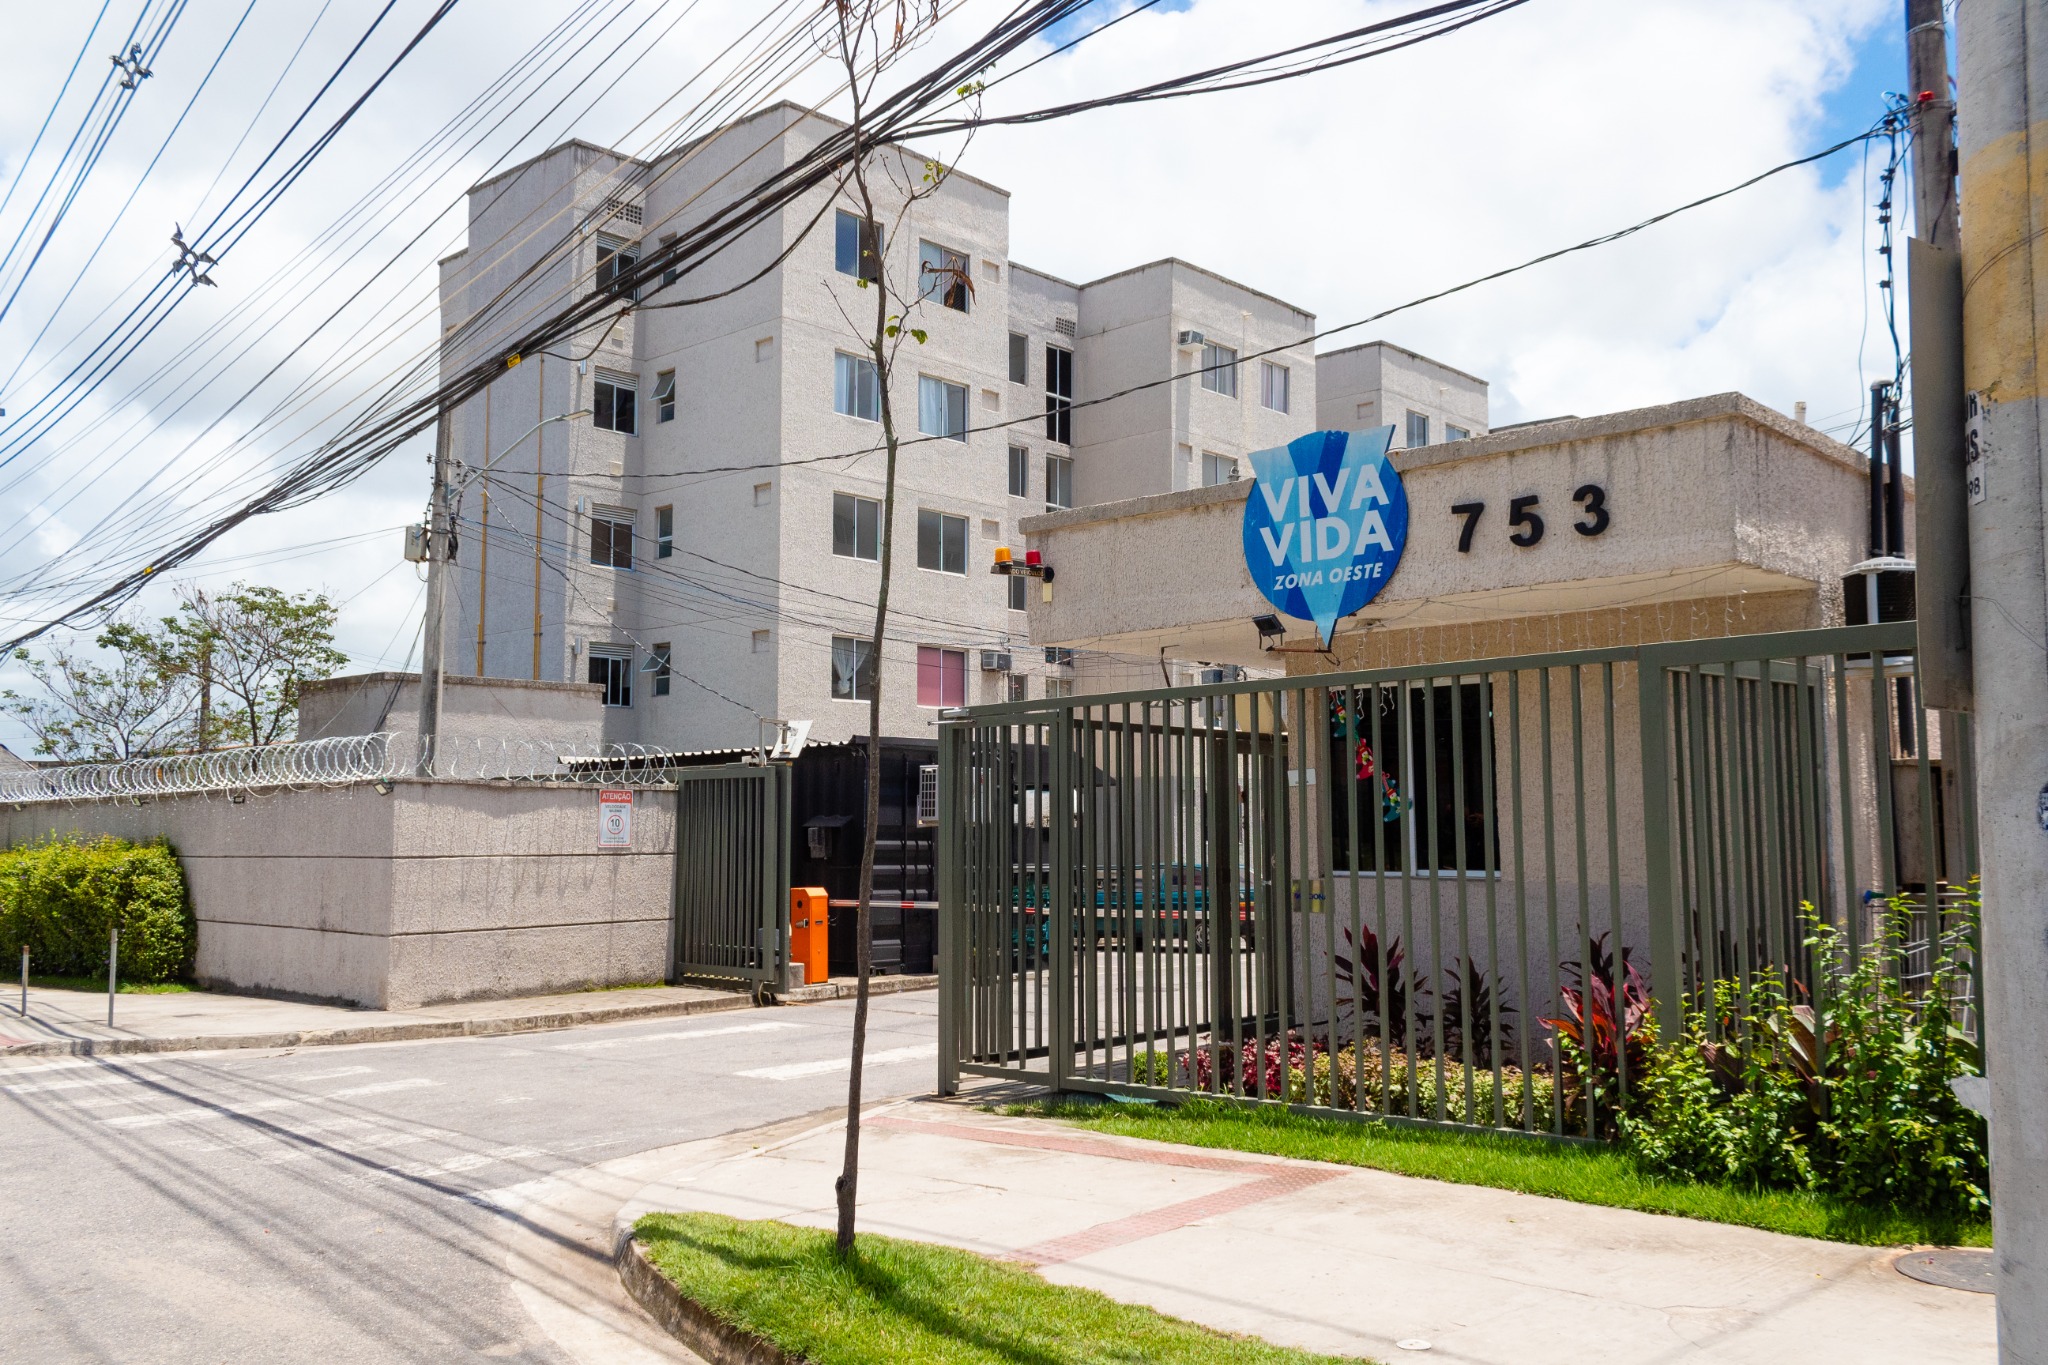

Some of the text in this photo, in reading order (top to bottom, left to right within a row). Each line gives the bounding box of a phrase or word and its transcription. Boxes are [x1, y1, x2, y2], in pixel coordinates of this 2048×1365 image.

[1259, 464, 1389, 523] VIVA
[1259, 510, 1394, 567] VIDA
[1451, 484, 1611, 553] 753
[1273, 562, 1383, 590] ZONA OESTE
[602, 792, 631, 801] ATENÇÃO
[610, 818, 620, 828] 10
